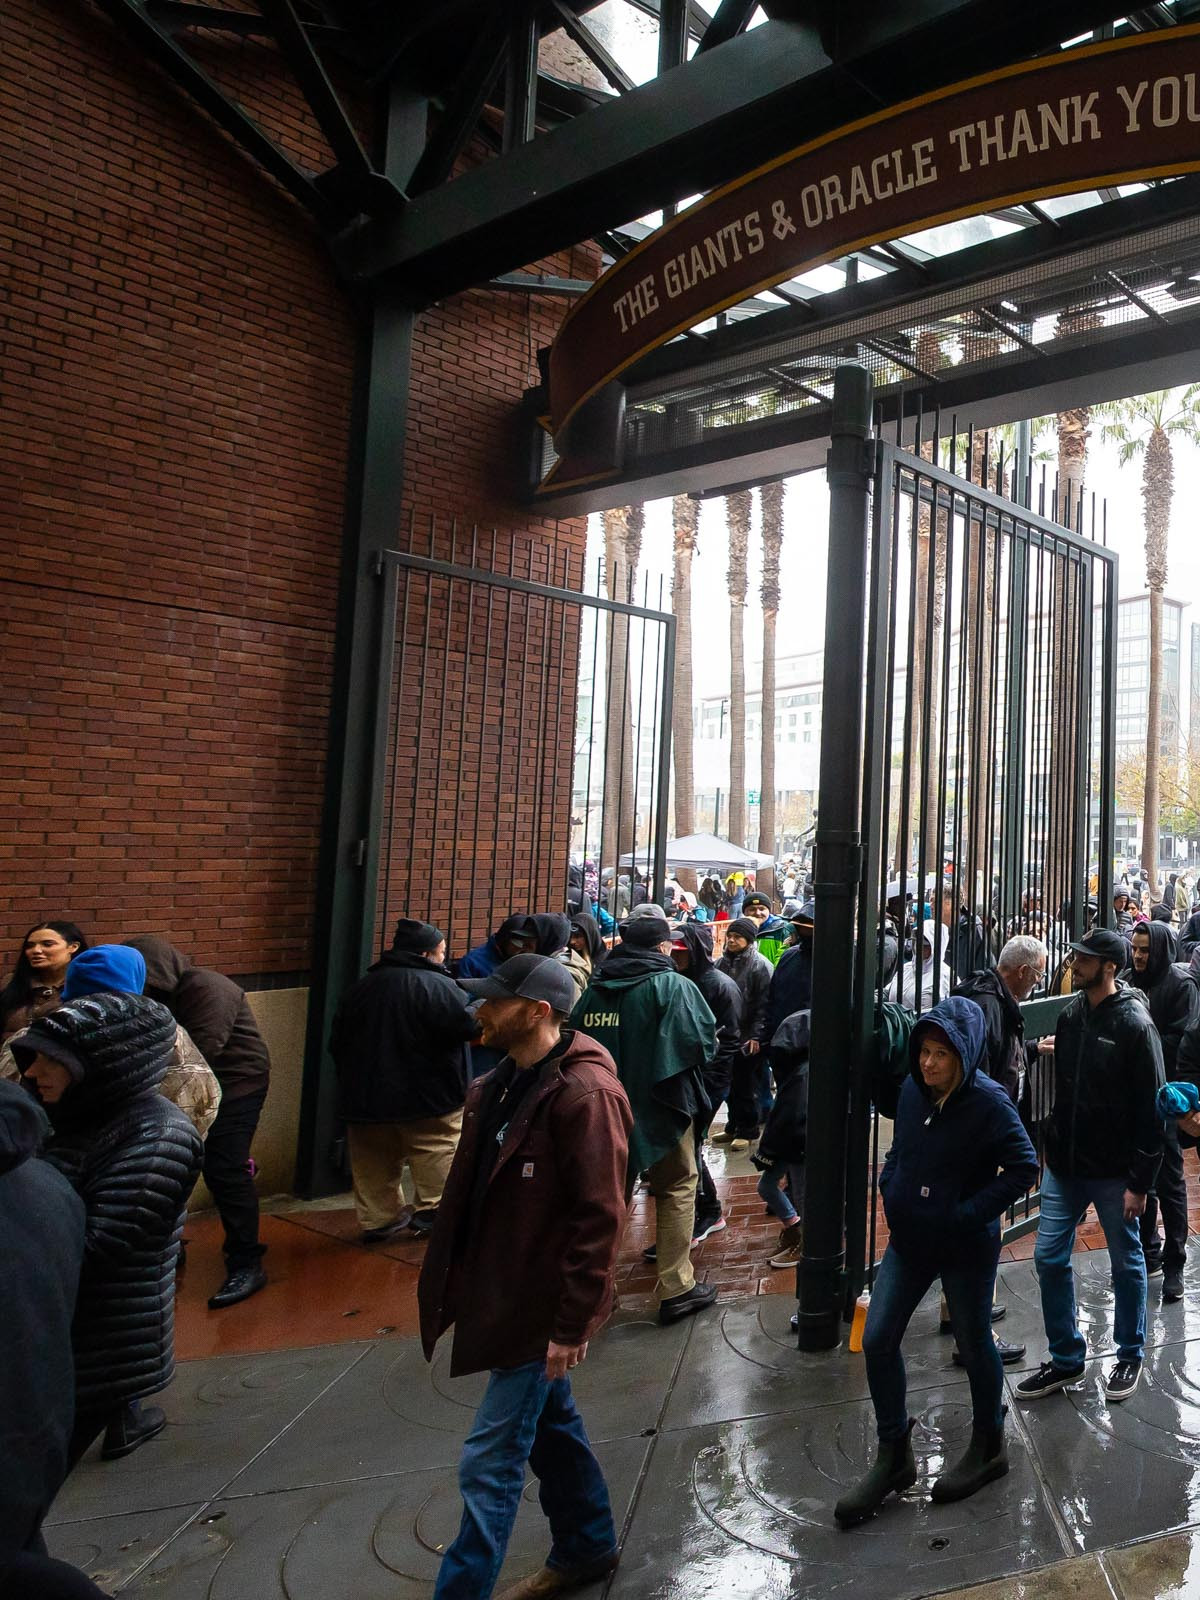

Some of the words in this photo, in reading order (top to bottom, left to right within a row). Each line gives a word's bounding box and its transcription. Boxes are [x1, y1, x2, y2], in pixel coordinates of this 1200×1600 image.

[613, 287, 660, 334] THE
[663, 208, 766, 299] GIANTS
[772, 201, 798, 243] &
[801, 137, 938, 230] ORACLE
[949, 91, 1102, 174] THANK
[583, 1012, 620, 1028] USH
